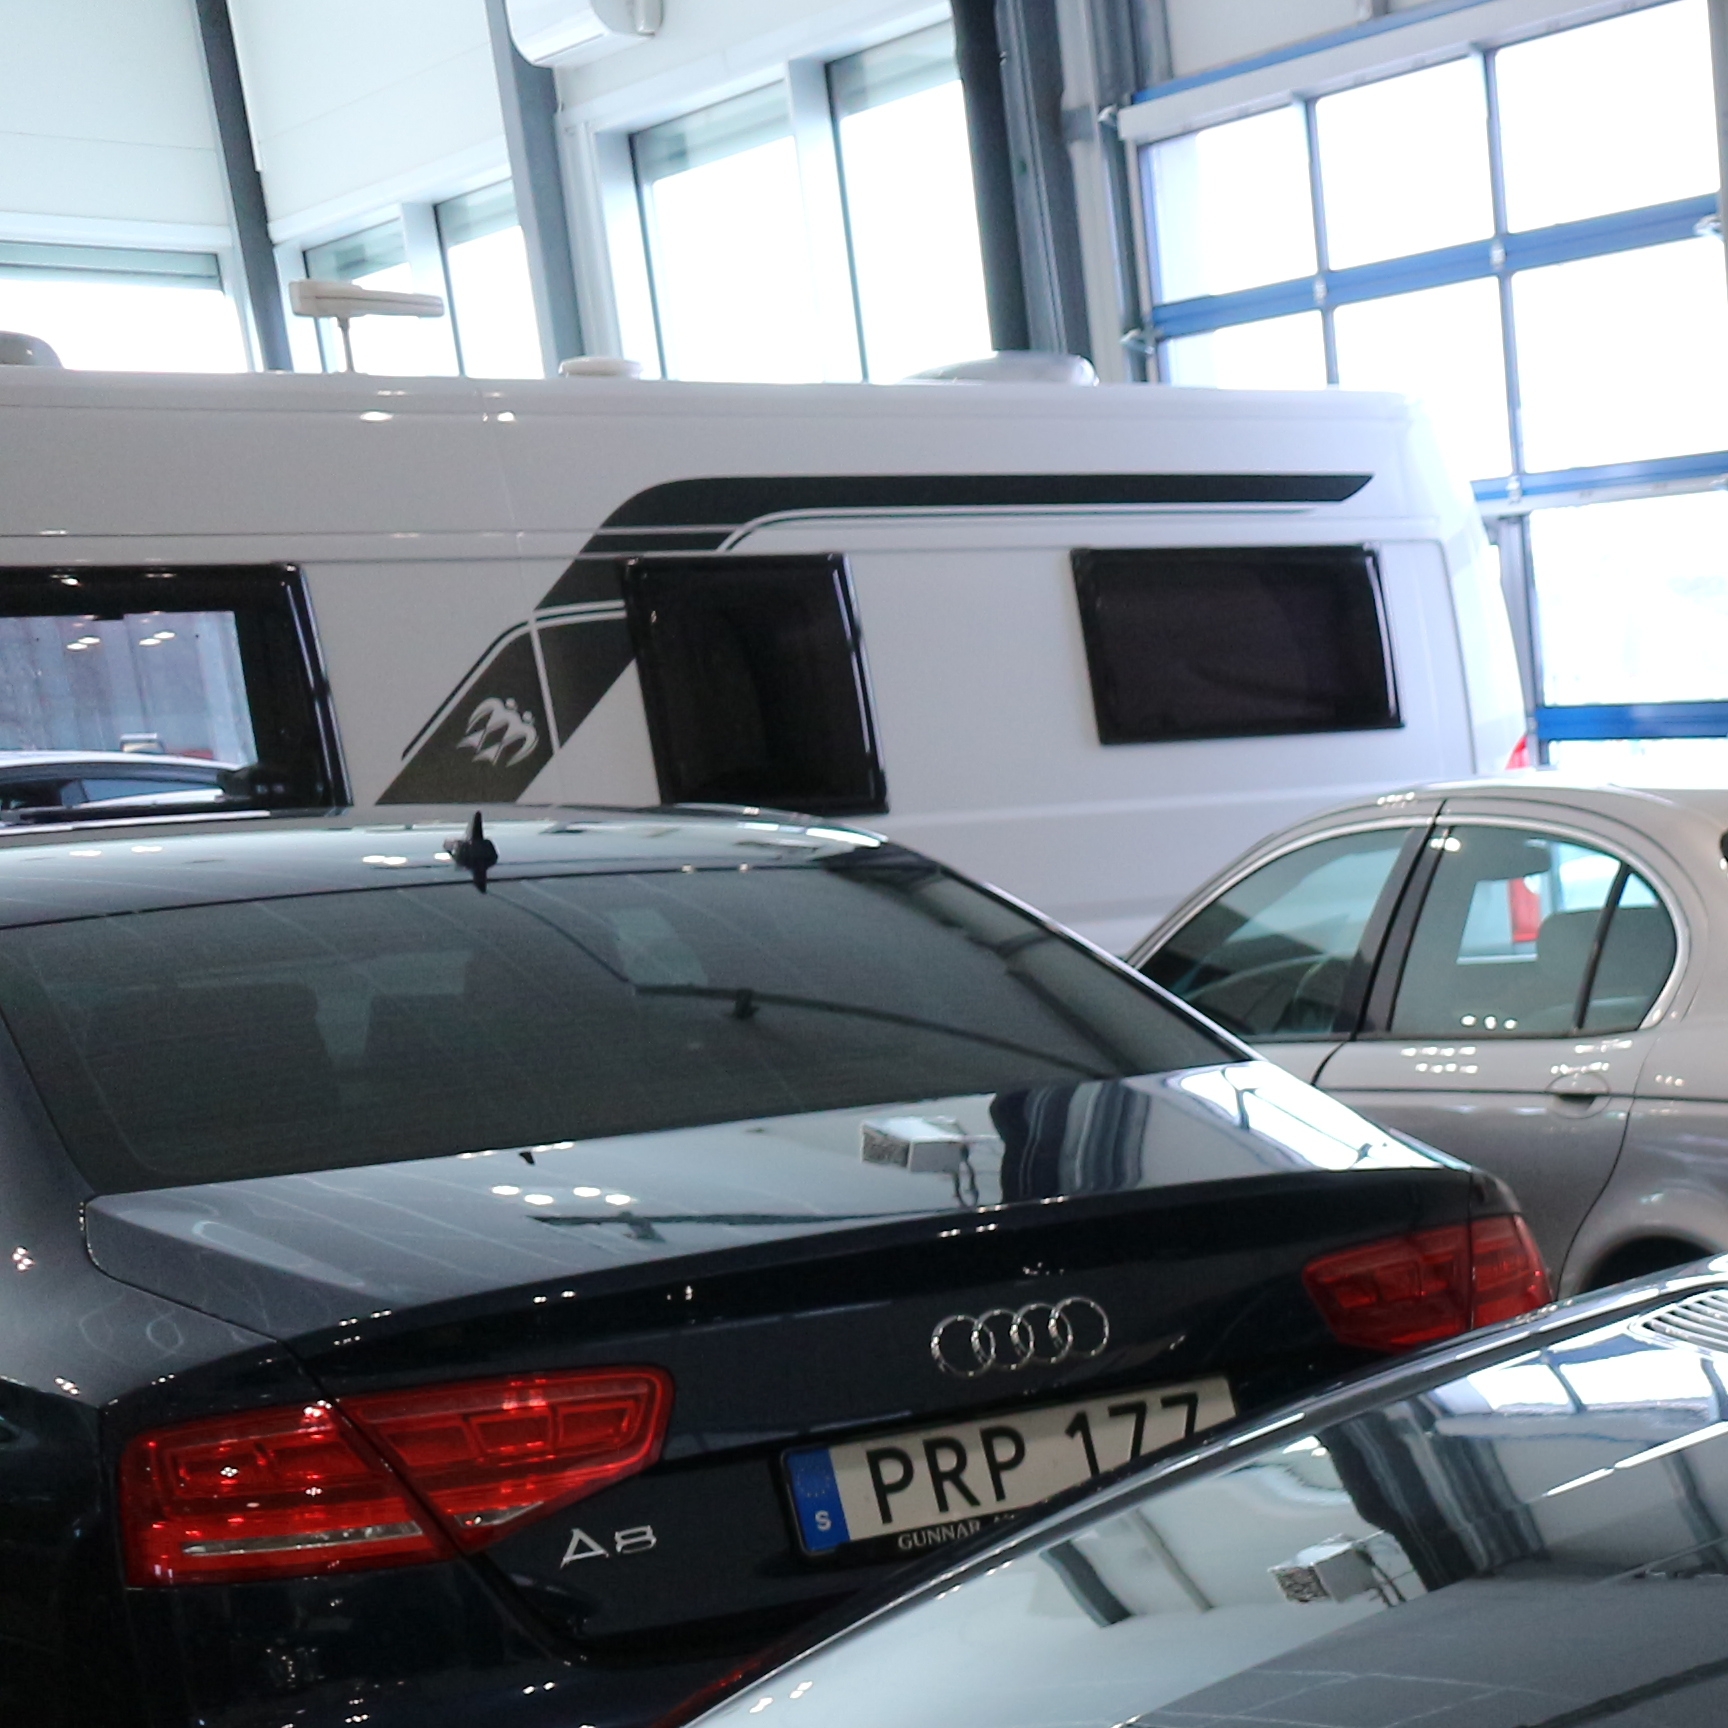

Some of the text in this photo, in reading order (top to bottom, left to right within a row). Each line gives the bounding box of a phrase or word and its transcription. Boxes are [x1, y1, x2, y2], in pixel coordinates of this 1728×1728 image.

[866, 1392, 1199, 1525] PRP 177
[814, 1510, 832, 1531] S
[898, 1519, 981, 1550] GUNNAR
[560, 1525, 657, 1568] A8
